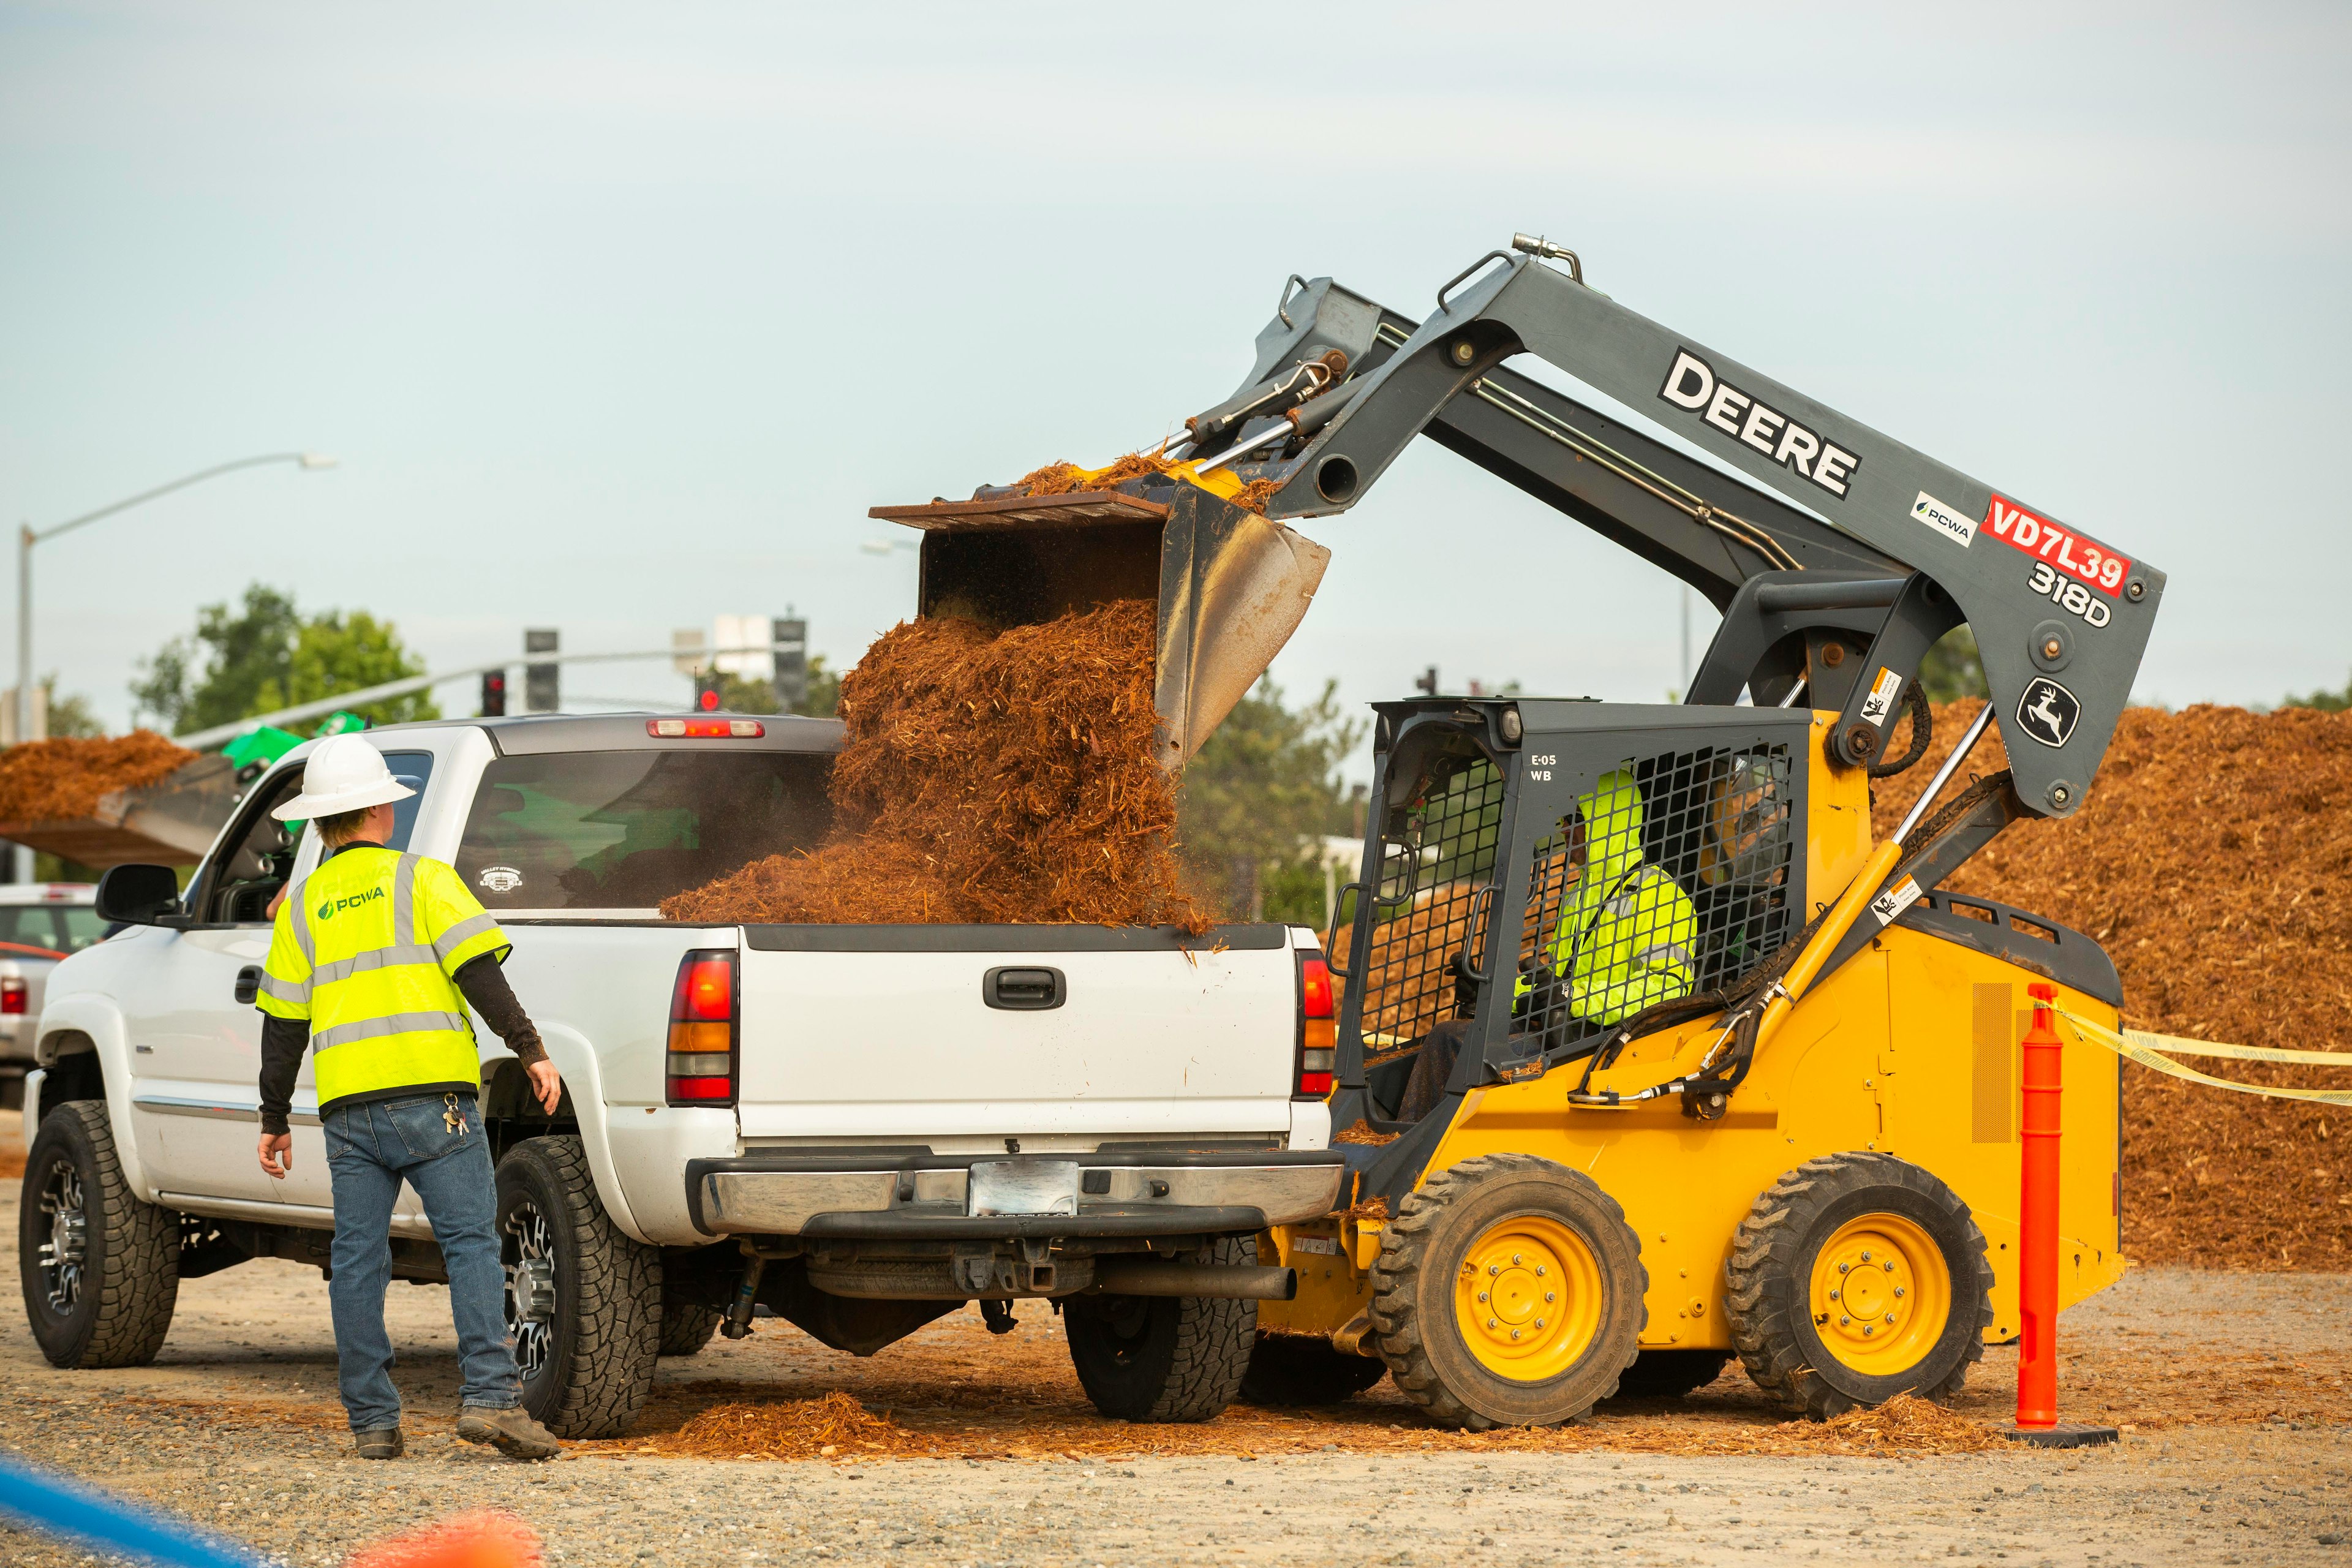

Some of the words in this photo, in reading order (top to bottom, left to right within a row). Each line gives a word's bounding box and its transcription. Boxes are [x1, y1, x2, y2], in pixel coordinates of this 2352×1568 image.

[1660, 349, 1859, 497] DEERE
[1928, 508, 1969, 539] PCWA
[1994, 500, 2123, 589] VD7L39
[2027, 561, 2111, 628] 318D
[1530, 771, 1551, 781] WB
[480, 866, 500, 875] VALLEY
[499, 866, 521, 875] HYBRIDS
[336, 886, 385, 911] PCWA
[1591, 1226, 1633, 1385] Firestone
